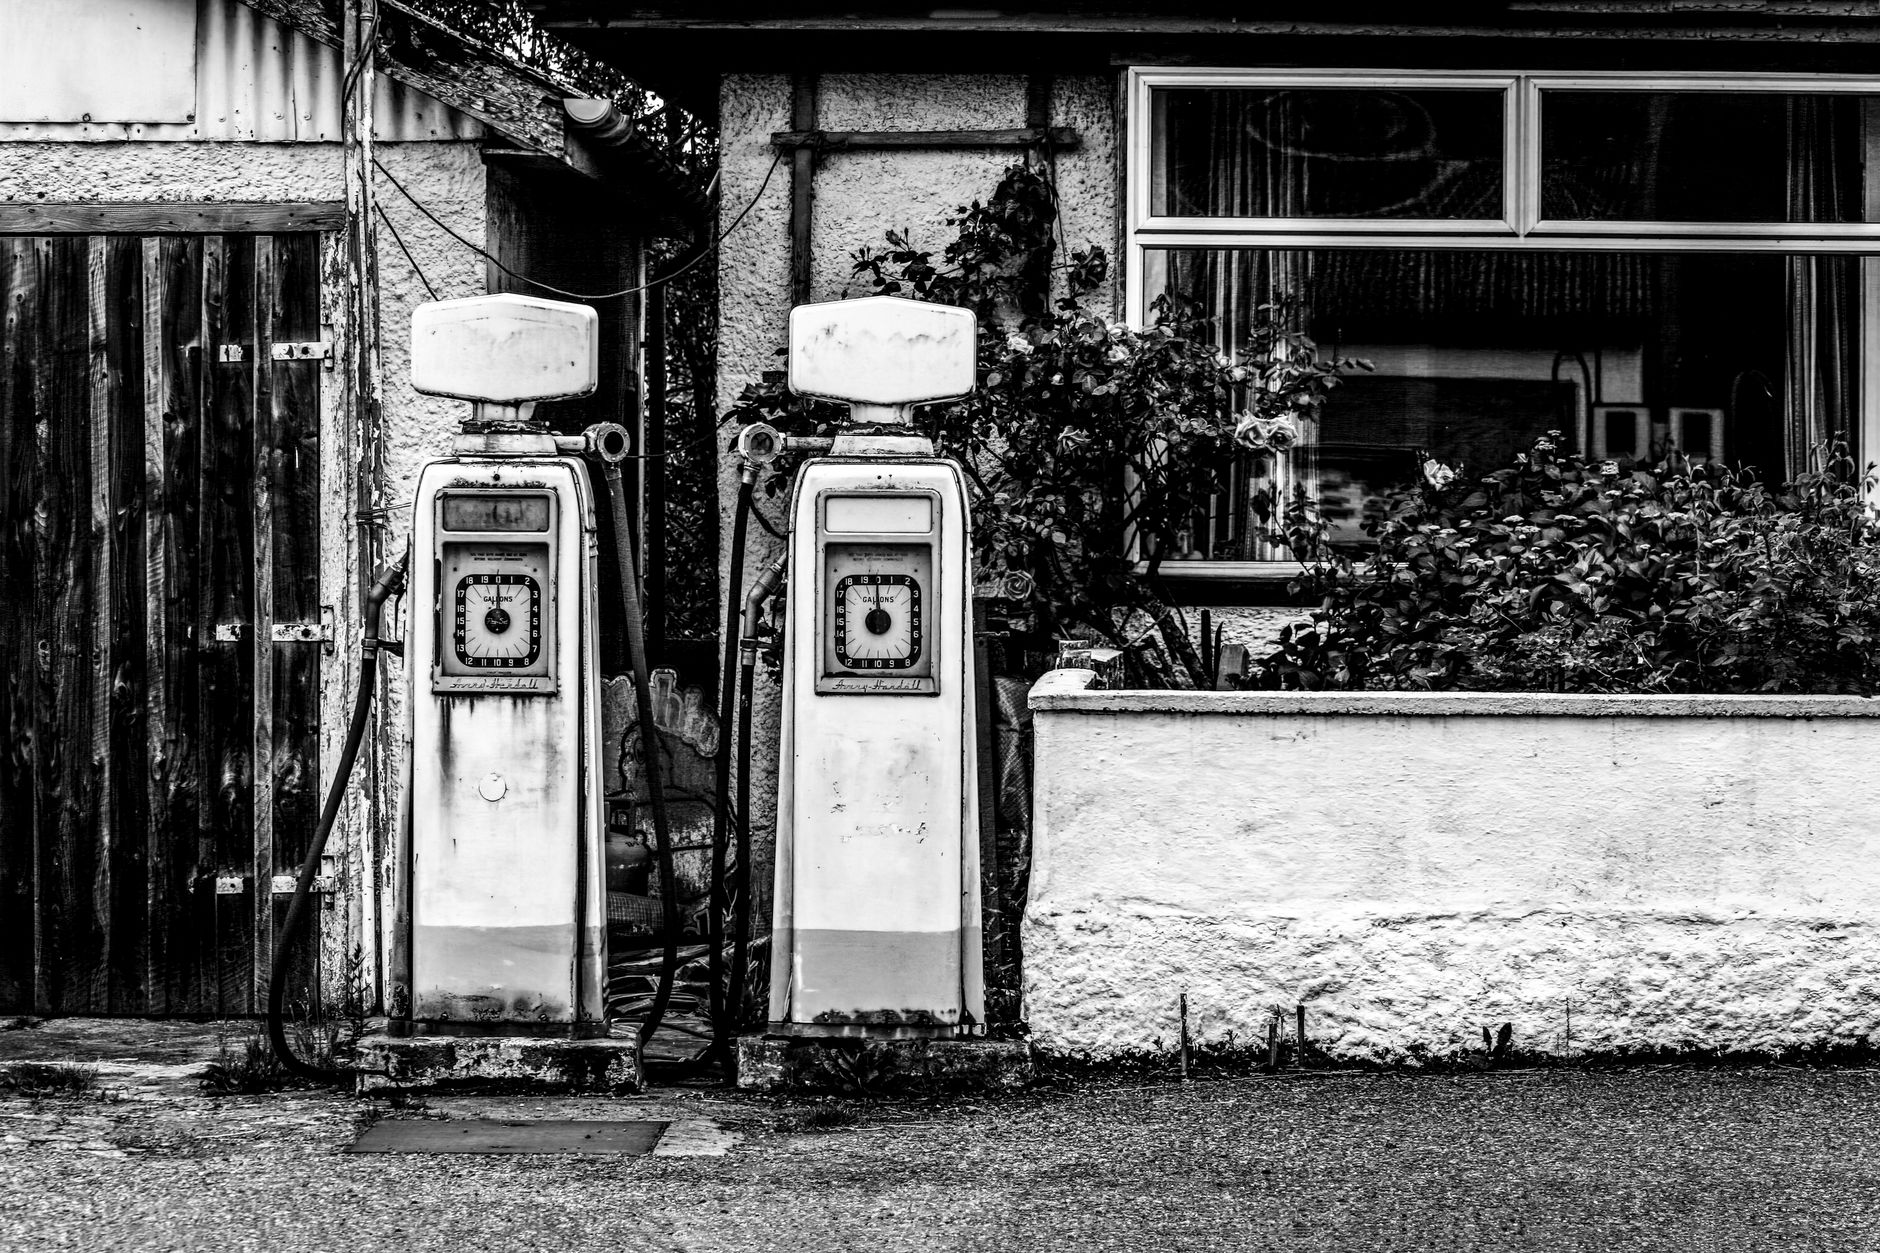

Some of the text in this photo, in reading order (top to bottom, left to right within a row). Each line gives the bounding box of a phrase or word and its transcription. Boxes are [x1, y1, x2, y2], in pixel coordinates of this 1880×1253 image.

[465, 576, 474, 585] 18
[481, 575, 489, 584] 19
[495, 575, 501, 584] 0
[524, 576, 531, 585] 2
[845, 577, 853, 586] 18
[860, 575, 869, 584] 19
[904, 577, 911, 585] 2
[457, 589, 465, 598] 17
[532, 590, 539, 599] 3
[836, 590, 845, 598] 17
[913, 590, 919, 598] 3
[483, 595, 513, 603] GALONS
[457, 604, 465, 613] 16
[532, 604, 539, 613] 4
[836, 605, 845, 614] 16
[913, 604, 920, 613] 4
[457, 616, 465, 625] 15
[532, 617, 539, 626] 5
[836, 617, 845, 626] 15
[913, 617, 919, 626] 5
[457, 628, 465, 637] 14
[532, 629, 538, 638] 6
[836, 630, 845, 638] 14
[913, 630, 919, 638] 6
[456, 644, 465, 652] 13
[532, 644, 538, 653] 7
[836, 645, 845, 654] 13
[913, 645, 919, 654] 7
[465, 657, 530, 667] 12 11 10 9 8
[844, 658, 911, 668] 12 11 10 9 8
